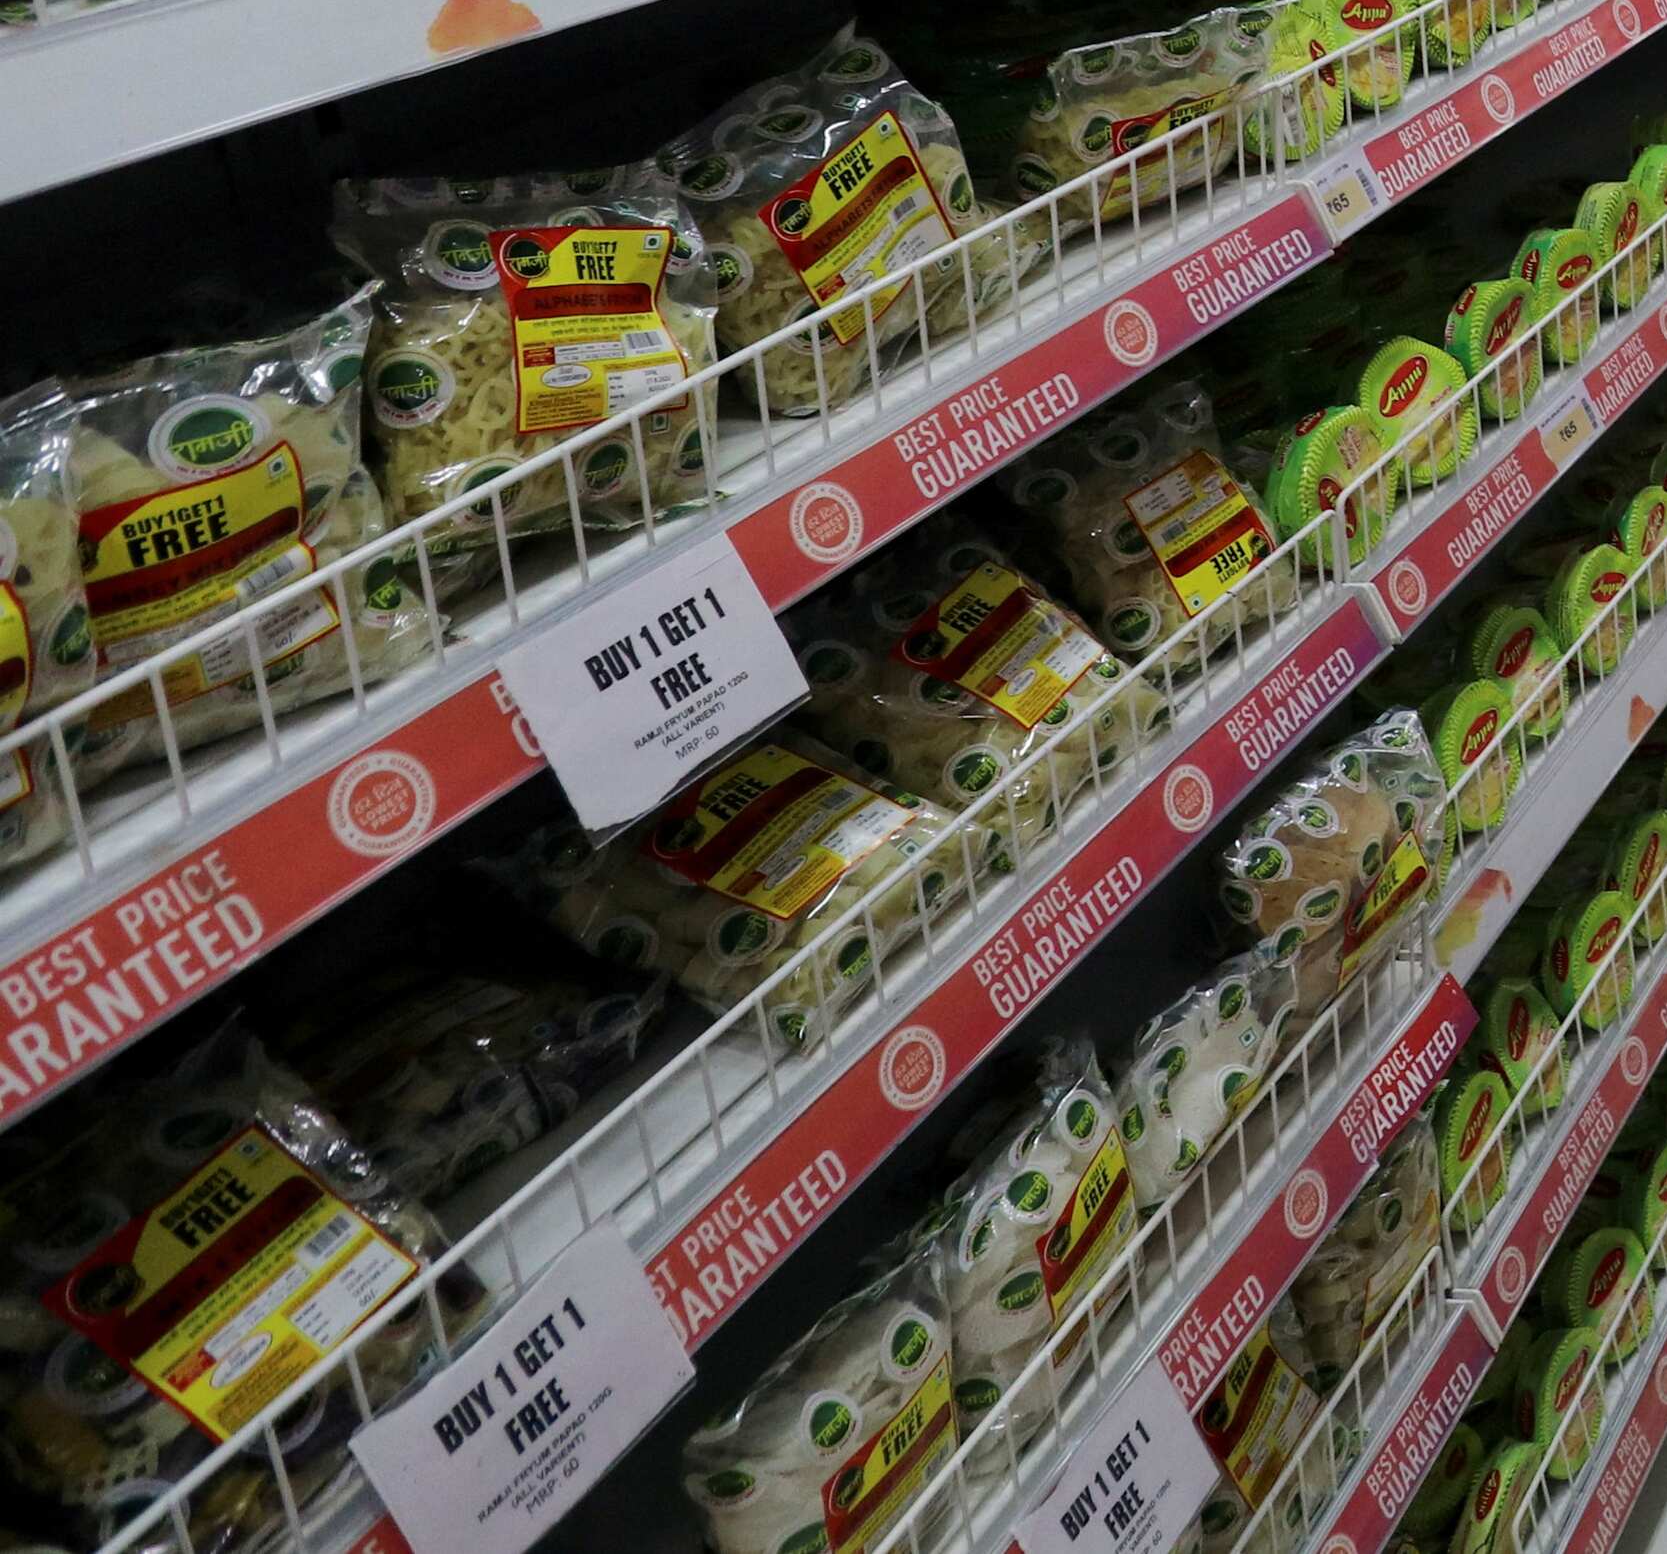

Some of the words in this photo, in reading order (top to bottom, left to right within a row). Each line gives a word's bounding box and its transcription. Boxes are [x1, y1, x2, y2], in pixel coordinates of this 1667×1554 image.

[1376, 122, 1471, 199] GUARANTEED
[1398, 122, 1427, 150] BEST
[1426, 100, 1460, 130] PRICE
[827, 150, 878, 201] FREE
[1326, 193, 1350, 215] ₹65
[575, 255, 615, 280] FREE
[1186, 227, 1313, 326] GUARANTEED
[894, 414, 946, 466] BEST
[951, 376, 1009, 428] PRICE
[911, 371, 1081, 500] GUARANTEED
[1556, 418, 1580, 445] ₹65
[127, 509, 232, 569] FREE
[584, 635, 642, 692] BUY
[639, 625, 662, 658] 1
[658, 597, 707, 647] GET
[704, 587, 726, 619] 1
[634, 723, 664, 750] RAMJI
[664, 704, 696, 734] FRYUM
[697, 685, 727, 709] PAPAD
[727, 670, 750, 689] 120G
[650, 651, 713, 711] FREE
[662, 728, 684, 748] (ALL
[684, 702, 726, 732] VARIENT)
[675, 736, 703, 761] MRP:
[704, 725, 720, 742] 60
[359, 789, 410, 824] LOWEST
[3, 928, 105, 1020] BEST
[115, 849, 236, 946] PRICE
[971, 937, 1024, 997] BEST
[1020, 874, 1079, 949] PRICE
[987, 853, 1145, 1022] GUARANTEED
[171, 1179, 258, 1248] FREE
[1080, 1169, 1113, 1218] FREE
[432, 1379, 495, 1455] BUY
[494, 1361, 517, 1397] 1
[513, 1313, 565, 1378] GET
[562, 1297, 585, 1331] 1
[503, 1377, 570, 1456] FREE
[477, 1485, 512, 1524] RAMJI
[513, 1449, 551, 1492] FRYUM
[551, 1413, 586, 1451] PAPAD
[511, 1478, 538, 1510] (ALL
[537, 1431, 586, 1481] VARIENT)
[526, 1477, 561, 1514] MRP:
[562, 1457, 581, 1479] 60
[1059, 1485, 1098, 1542] BUY
[1094, 1471, 1111, 1497] 1
[1105, 1432, 1139, 1483] GET
[1135, 1419, 1151, 1444] 1
[1104, 1481, 1145, 1541] FREE
